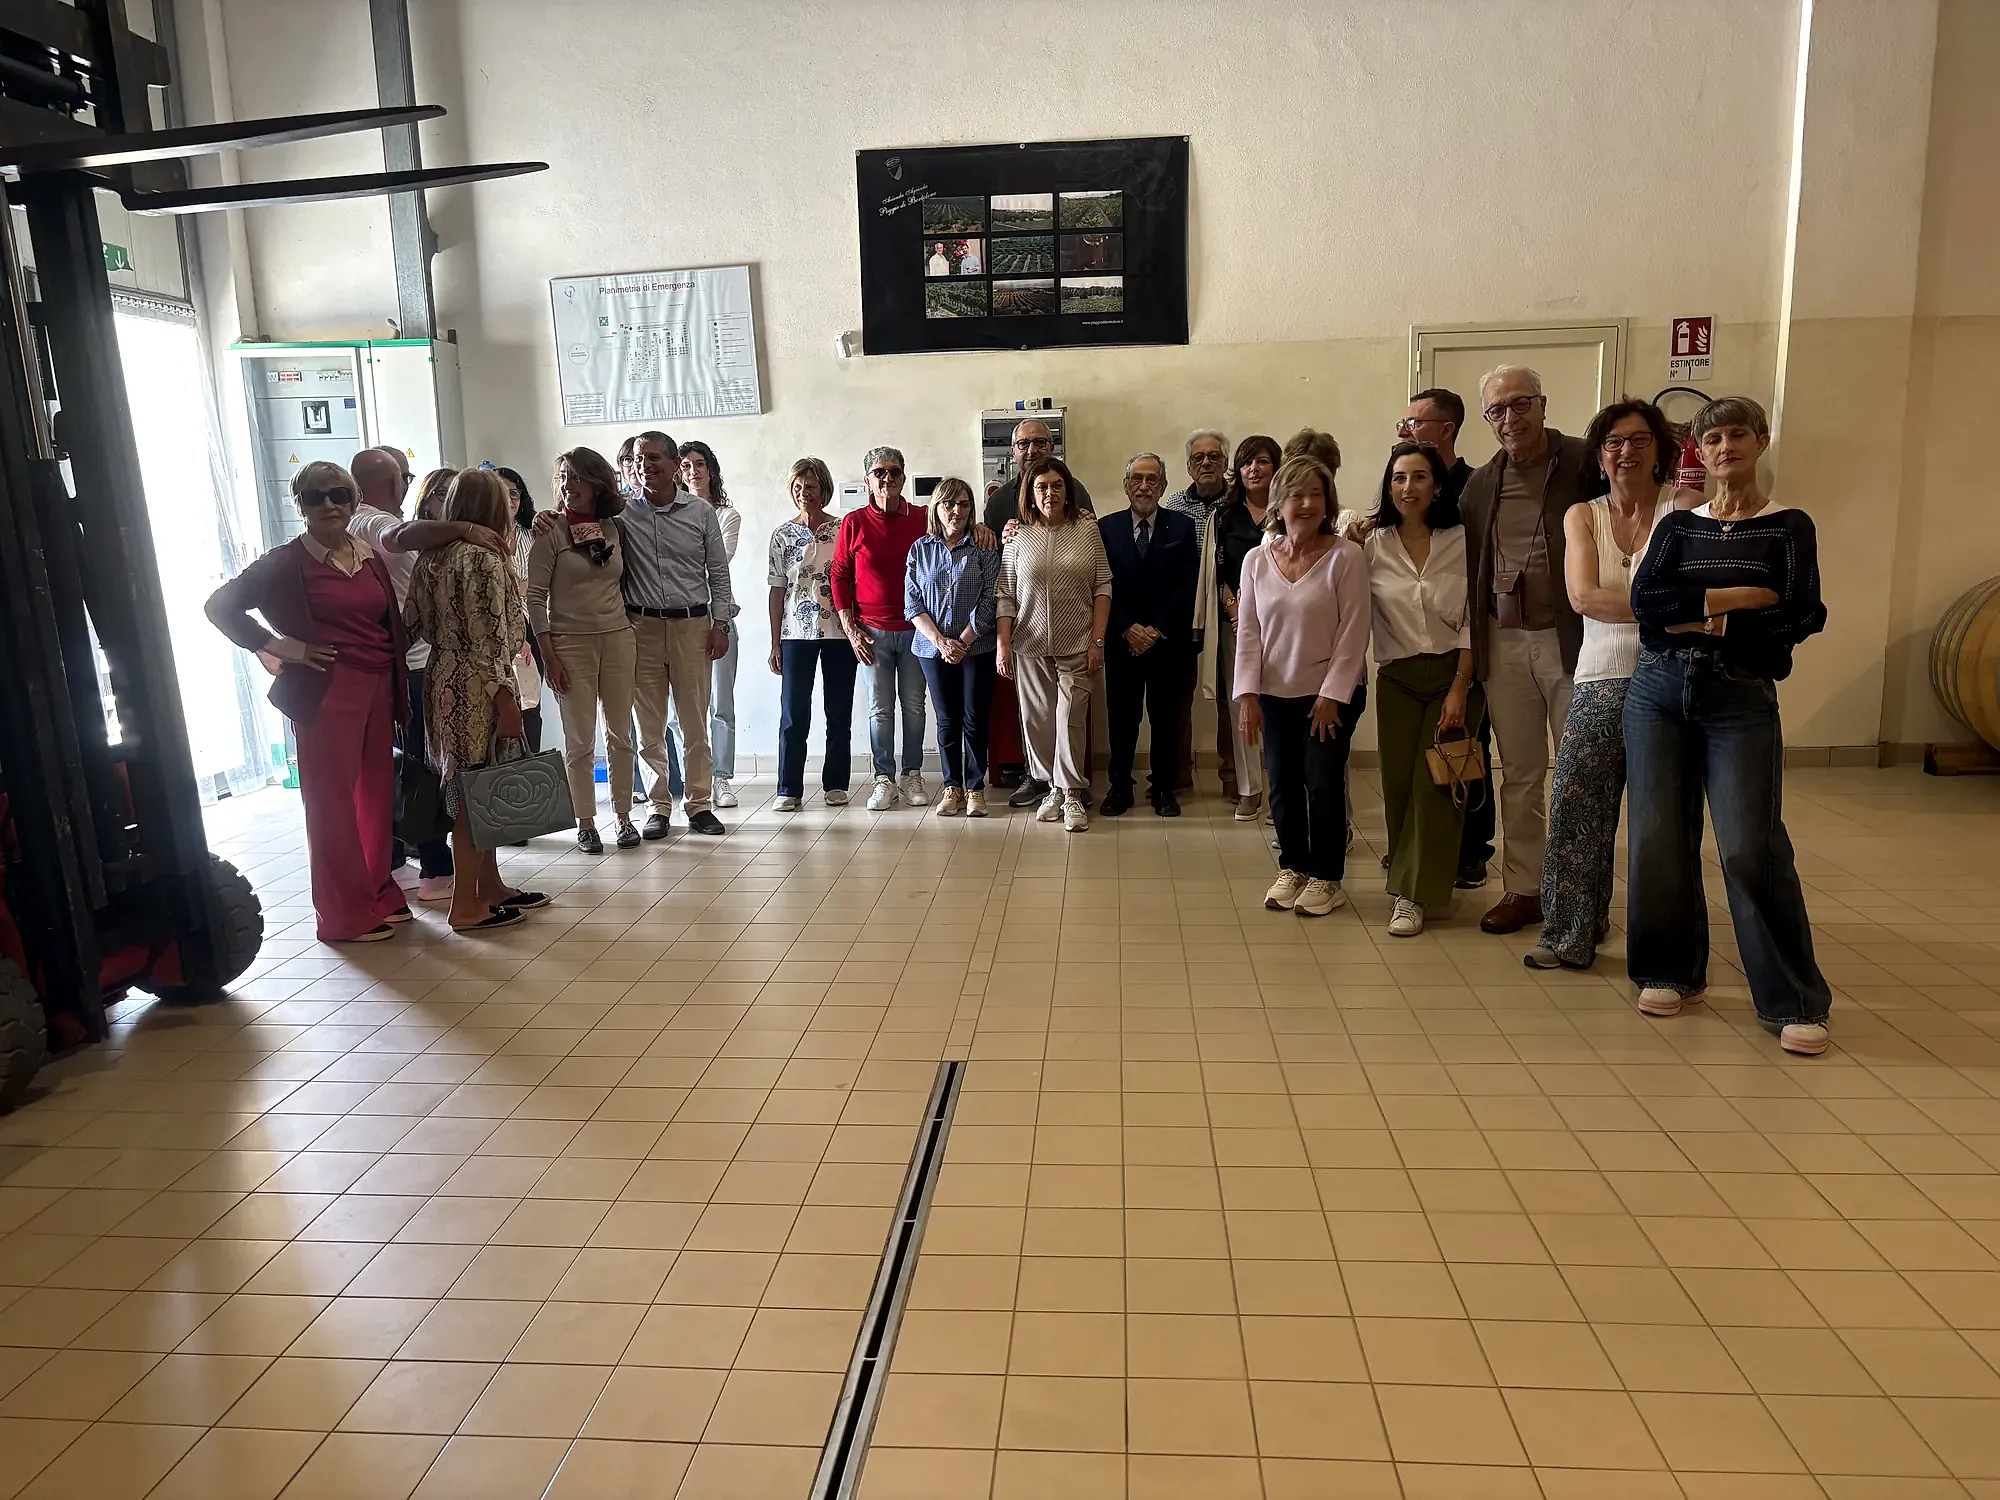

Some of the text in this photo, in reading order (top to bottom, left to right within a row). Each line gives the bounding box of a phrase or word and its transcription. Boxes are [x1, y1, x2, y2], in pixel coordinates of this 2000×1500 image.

[599, 282, 696, 295] Planimetria di Emergenza
[1670, 358, 1710, 368] ESTINTORE
